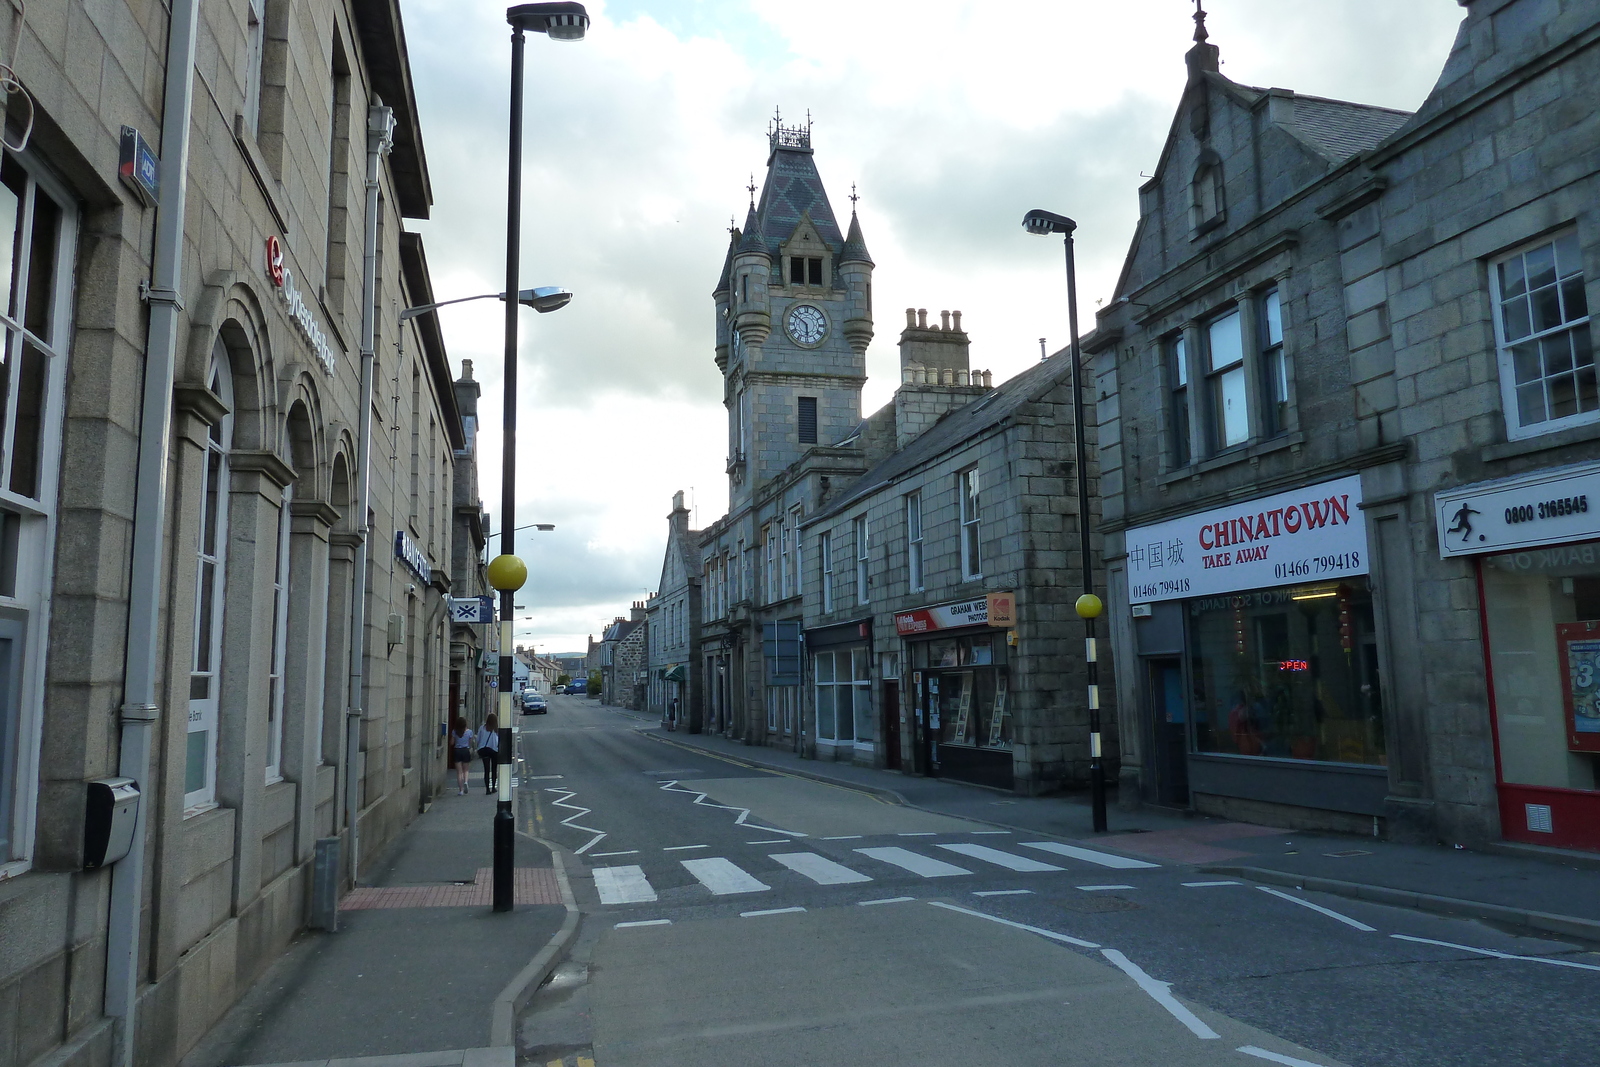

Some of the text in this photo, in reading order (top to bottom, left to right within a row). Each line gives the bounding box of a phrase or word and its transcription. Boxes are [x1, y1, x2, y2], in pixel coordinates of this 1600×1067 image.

[1199, 494, 1350, 550] CHINATOWN
[1504, 495, 1588, 524] 0800 3165545
[1130, 537, 1185, 571] 中国城
[1202, 545, 1270, 569] TAKE AWAY
[1274, 551, 1360, 579] 01466 799418
[1133, 577, 1190, 598] 01466 799418
[950, 603, 972, 615] GRAHAM
